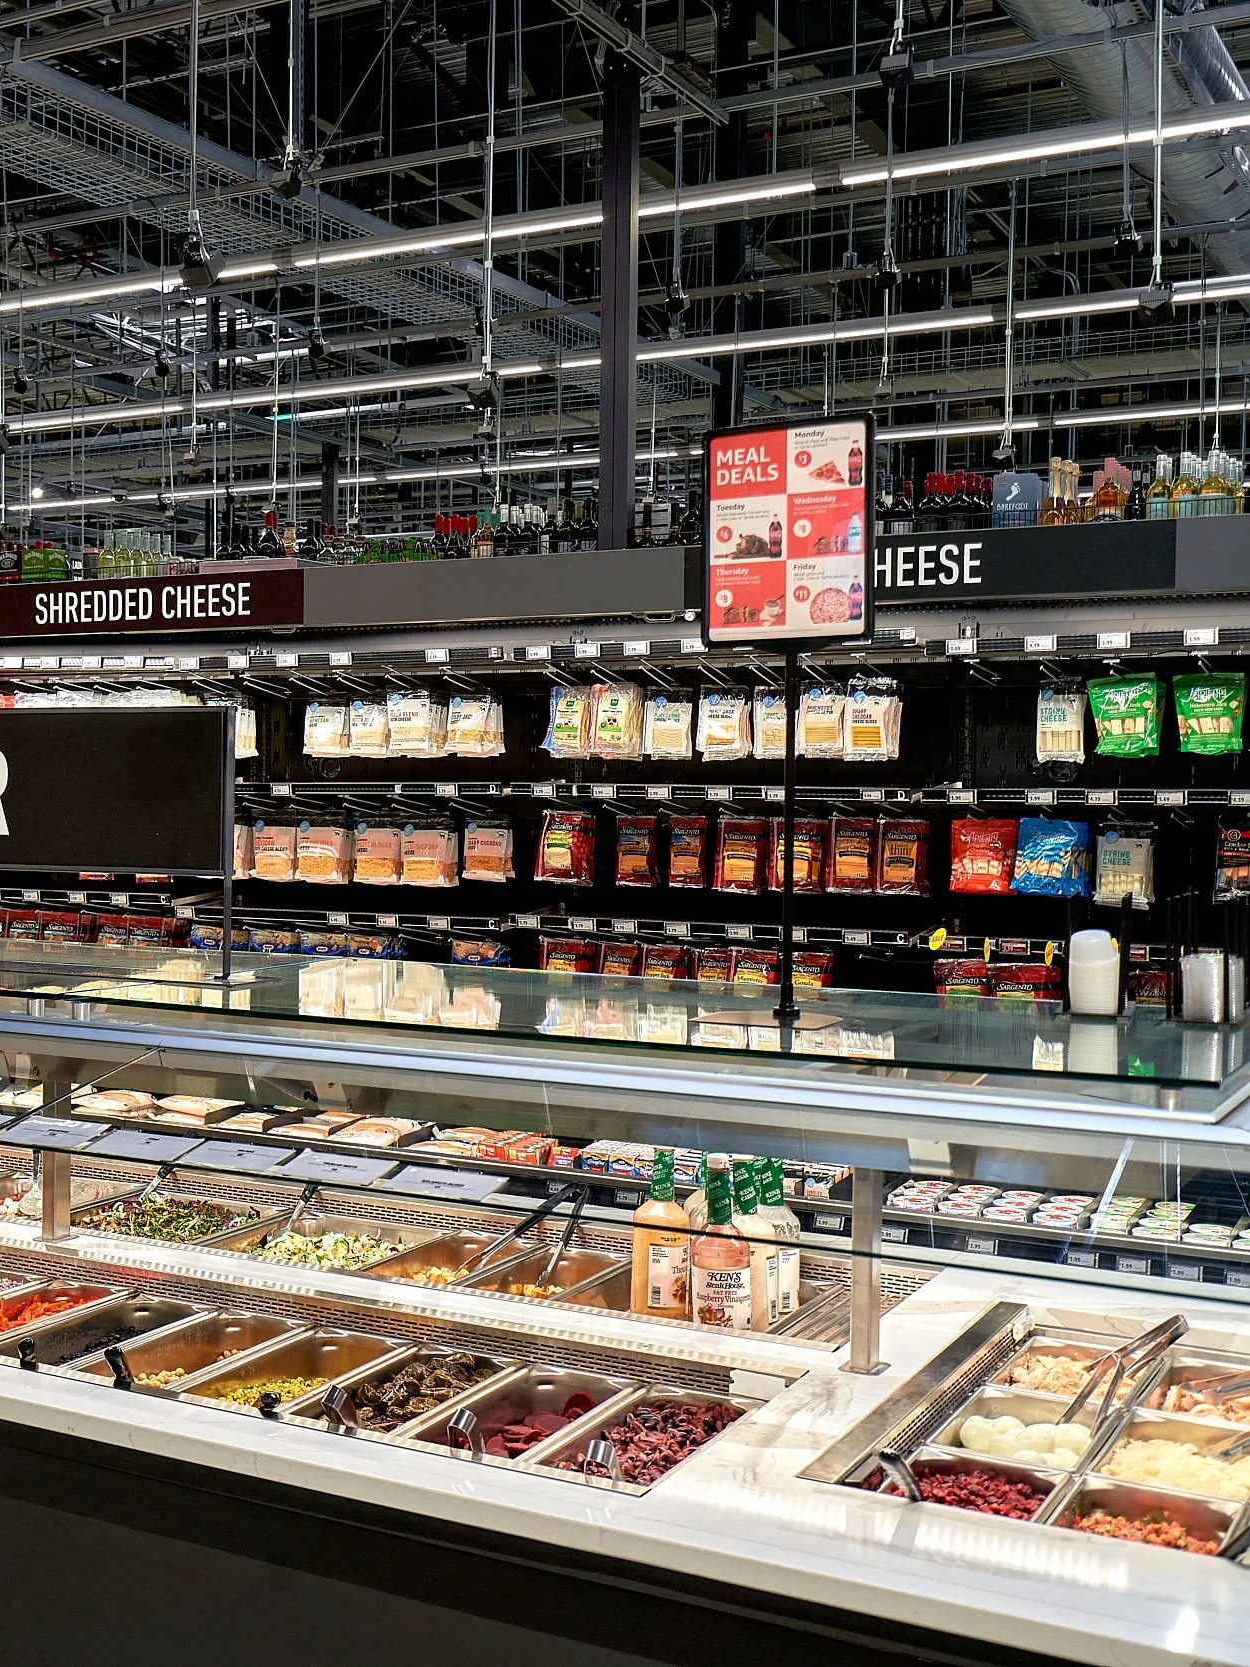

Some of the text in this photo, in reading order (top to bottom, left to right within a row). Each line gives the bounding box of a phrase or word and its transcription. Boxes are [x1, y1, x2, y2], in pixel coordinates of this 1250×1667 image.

[794, 430, 825, 439] Monday
[716, 446, 770, 467] MEAL
[798, 455, 808, 465] $3
[716, 464, 779, 486] DEALS
[793, 495, 837, 505] Wednesday
[717, 503, 745, 512] Tuesday
[996, 503, 1029, 511] BAREFOOT
[798, 525, 806, 534] $8
[720, 530, 728, 540] $6
[794, 563, 817, 572] Friday
[874, 543, 983, 588] HEESE
[716, 568, 750, 576] Thursday
[795, 590, 808, 600] $11
[35, 582, 251, 625] SHREDDED CHEESE
[1040, 707, 1066, 716] STRING
[1040, 714, 1068, 724] CHEESE
[490, 785, 496, 793] D
[898, 791, 906, 800] D
[779, 833, 810, 841] SENTO
[966, 832, 999, 844] APLENTY
[890, 843, 909, 856] thin
[1102, 850, 1131, 858] STRING
[1102, 858, 1132, 866] CHEESE
[160, 896, 166, 904] C
[46, 924, 74, 933] SARGENTO
[489, 920, 496, 929] C
[101, 925, 126, 935] SARGENTO
[132, 928, 157, 937] SARGENTO
[897, 933, 905, 944] C
[931, 934, 945, 943] SALE
[550, 952, 576, 960] SARGENTO
[648, 958, 673, 966] SARGENTO
[739, 962, 766, 970] SARGENTO
[708, 1272, 742, 1283] KEN'S
[696, 1292, 725, 1305] Raspberry
